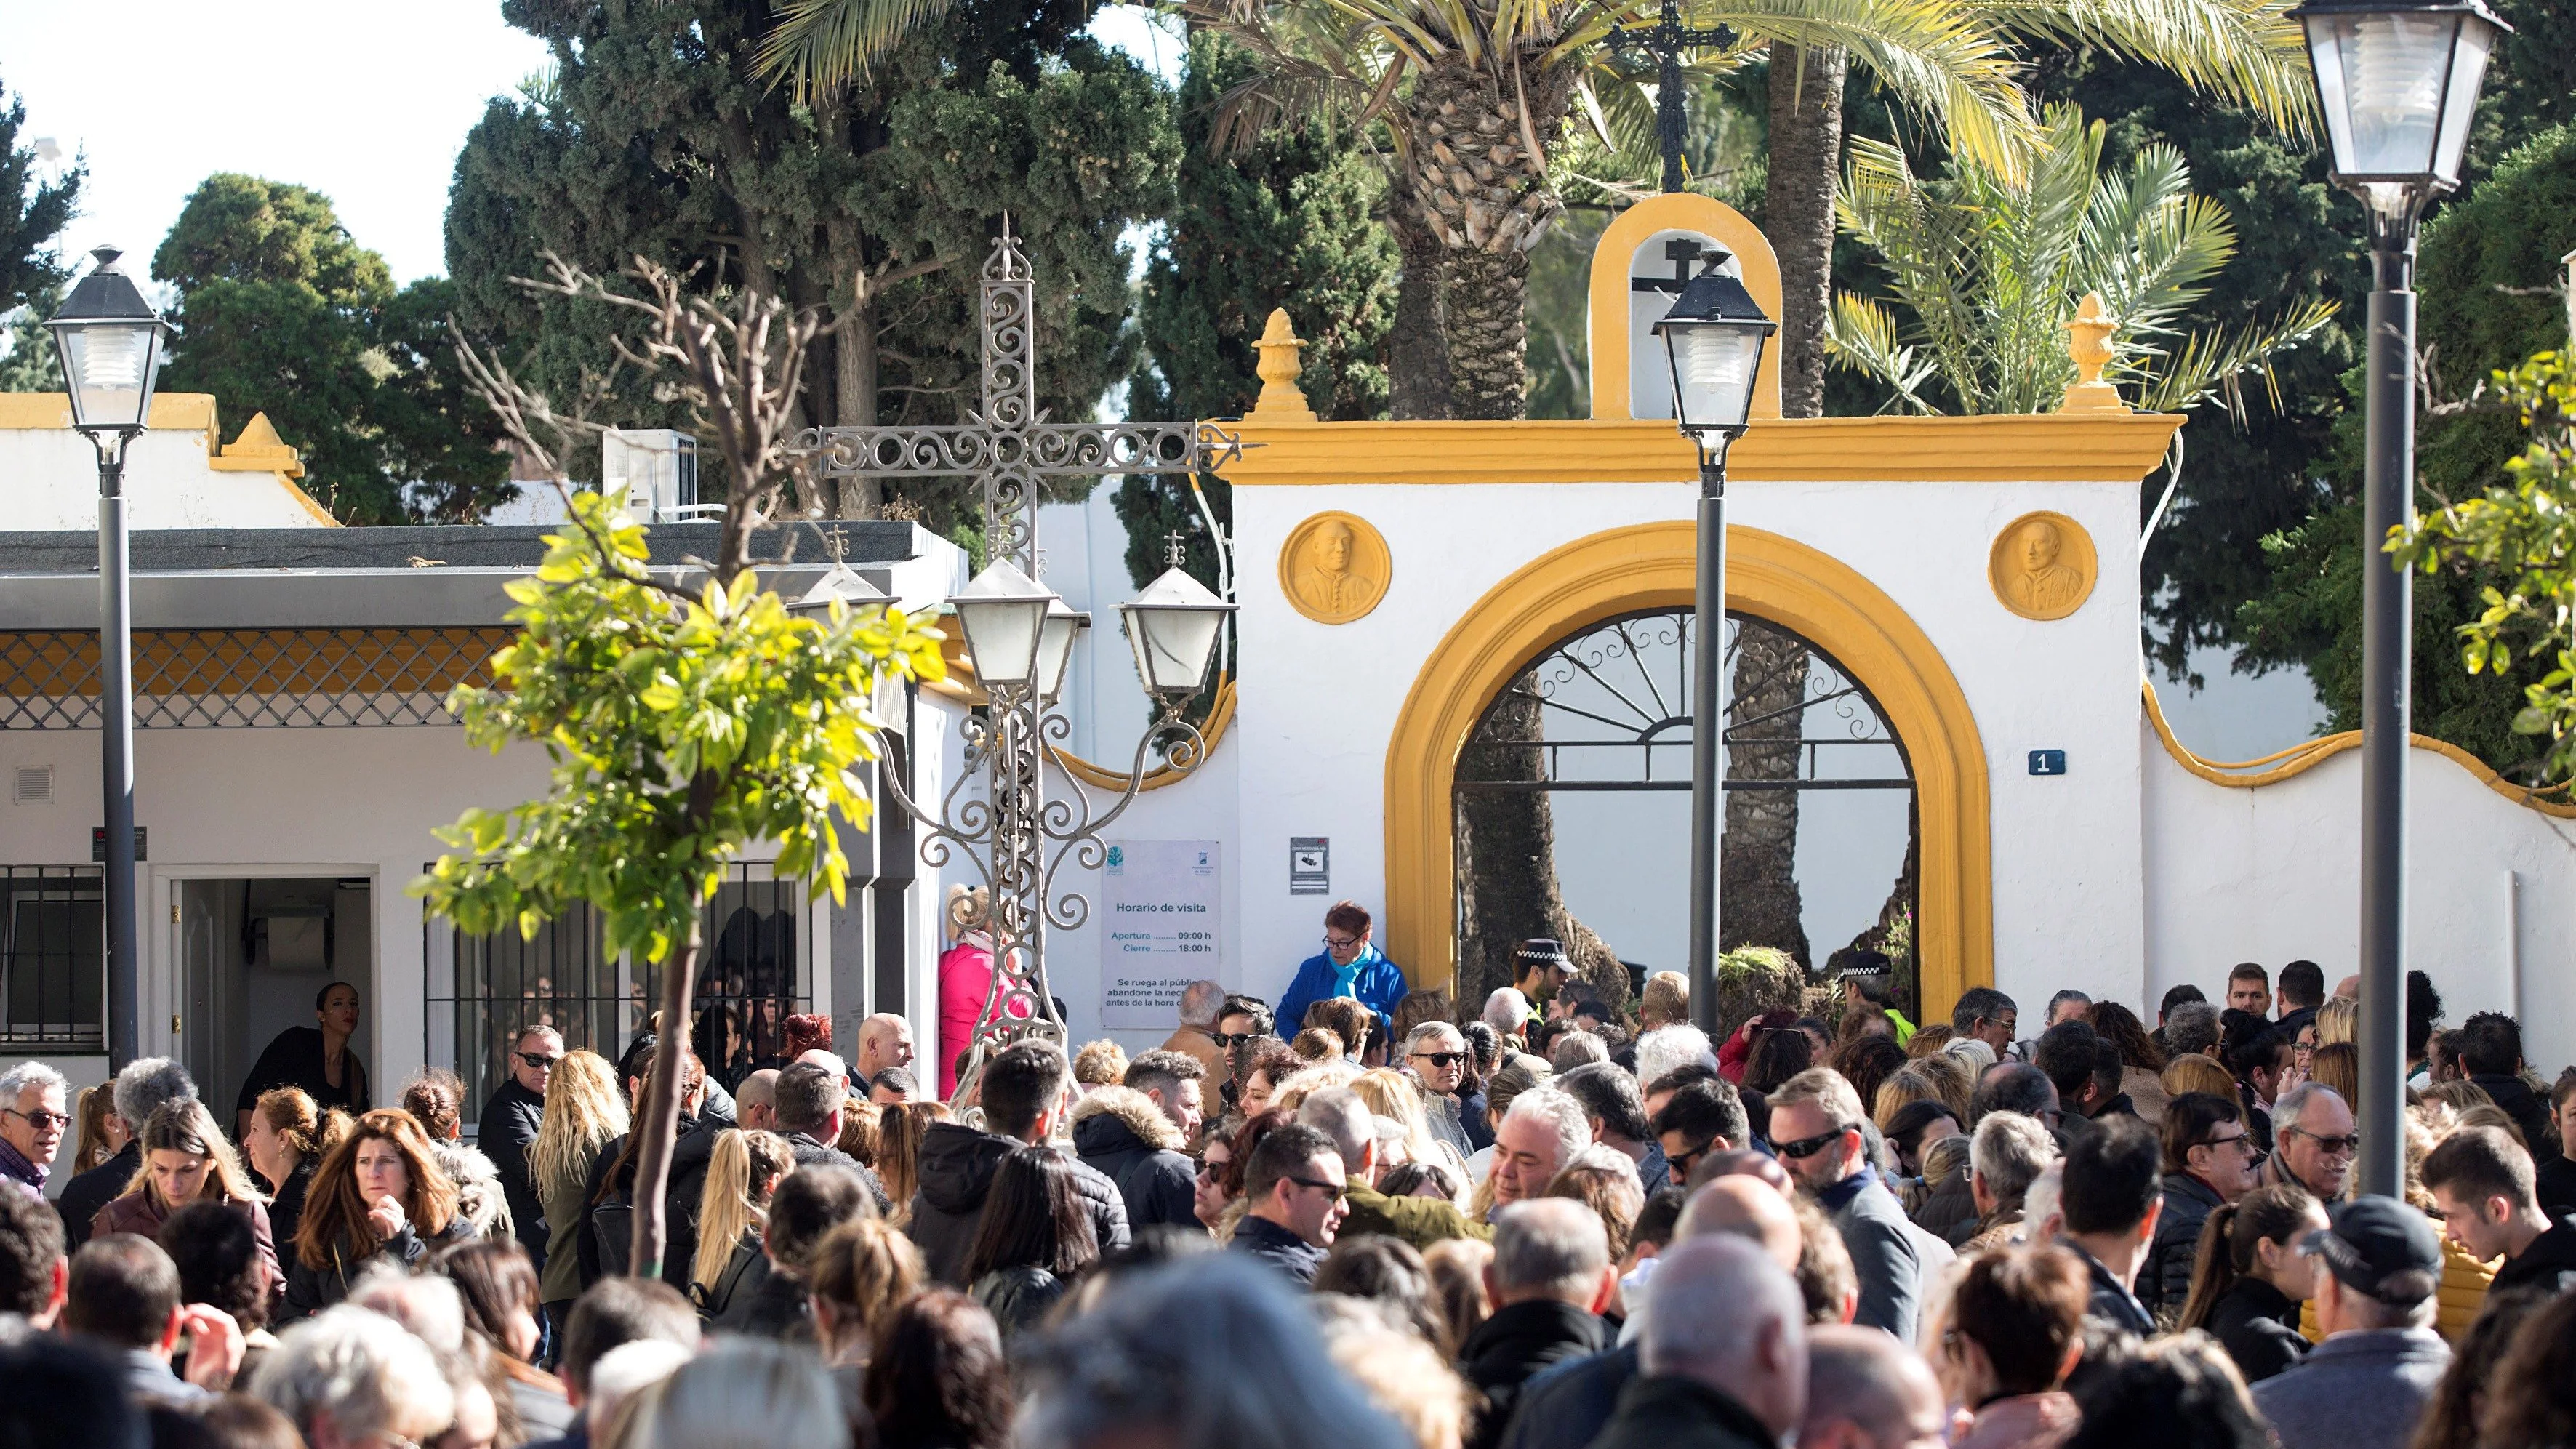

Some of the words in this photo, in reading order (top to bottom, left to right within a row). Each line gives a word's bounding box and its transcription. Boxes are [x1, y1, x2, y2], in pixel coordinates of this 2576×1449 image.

[2037, 753, 2050, 772] 1
[1116, 903, 1157, 912] Horario
[1160, 903, 1174, 912] de
[1177, 903, 1206, 912] visita
